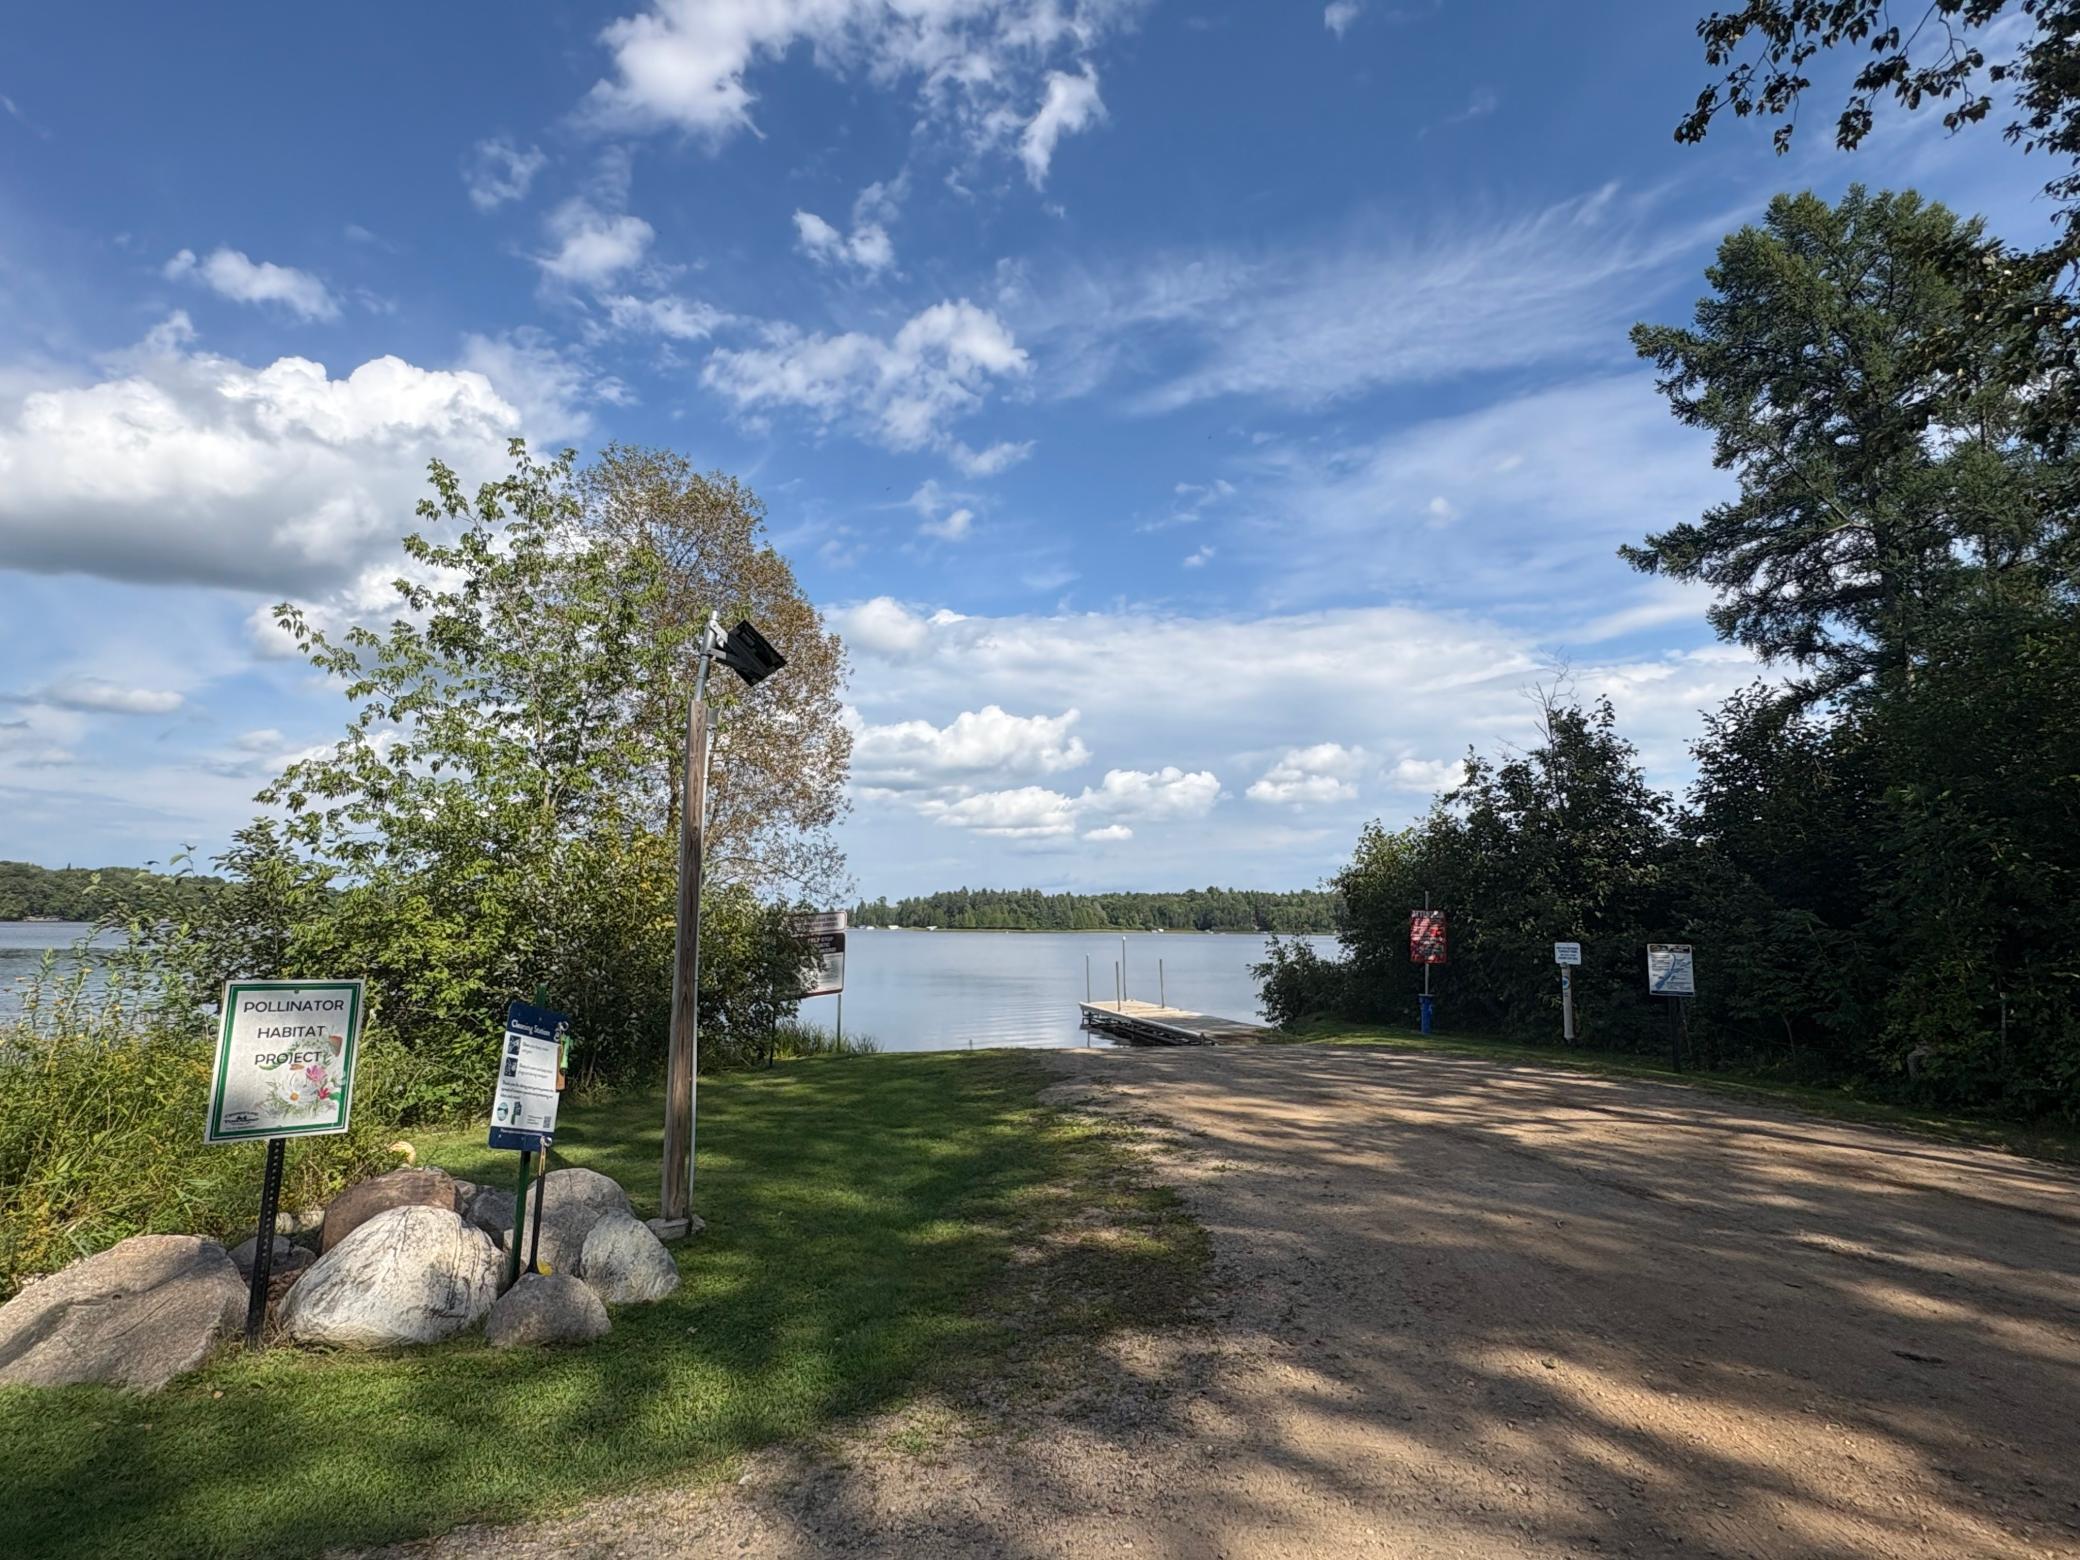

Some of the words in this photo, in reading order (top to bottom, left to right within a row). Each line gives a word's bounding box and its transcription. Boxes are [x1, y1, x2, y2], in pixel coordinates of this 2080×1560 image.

[244, 1000, 344, 1012] POLLINATOR
[257, 1026, 325, 1038] HABITAT
[511, 1019, 534, 1035] Cleaning
[534, 1025, 550, 1036] Station
[255, 1052, 322, 1065] PROJECT
